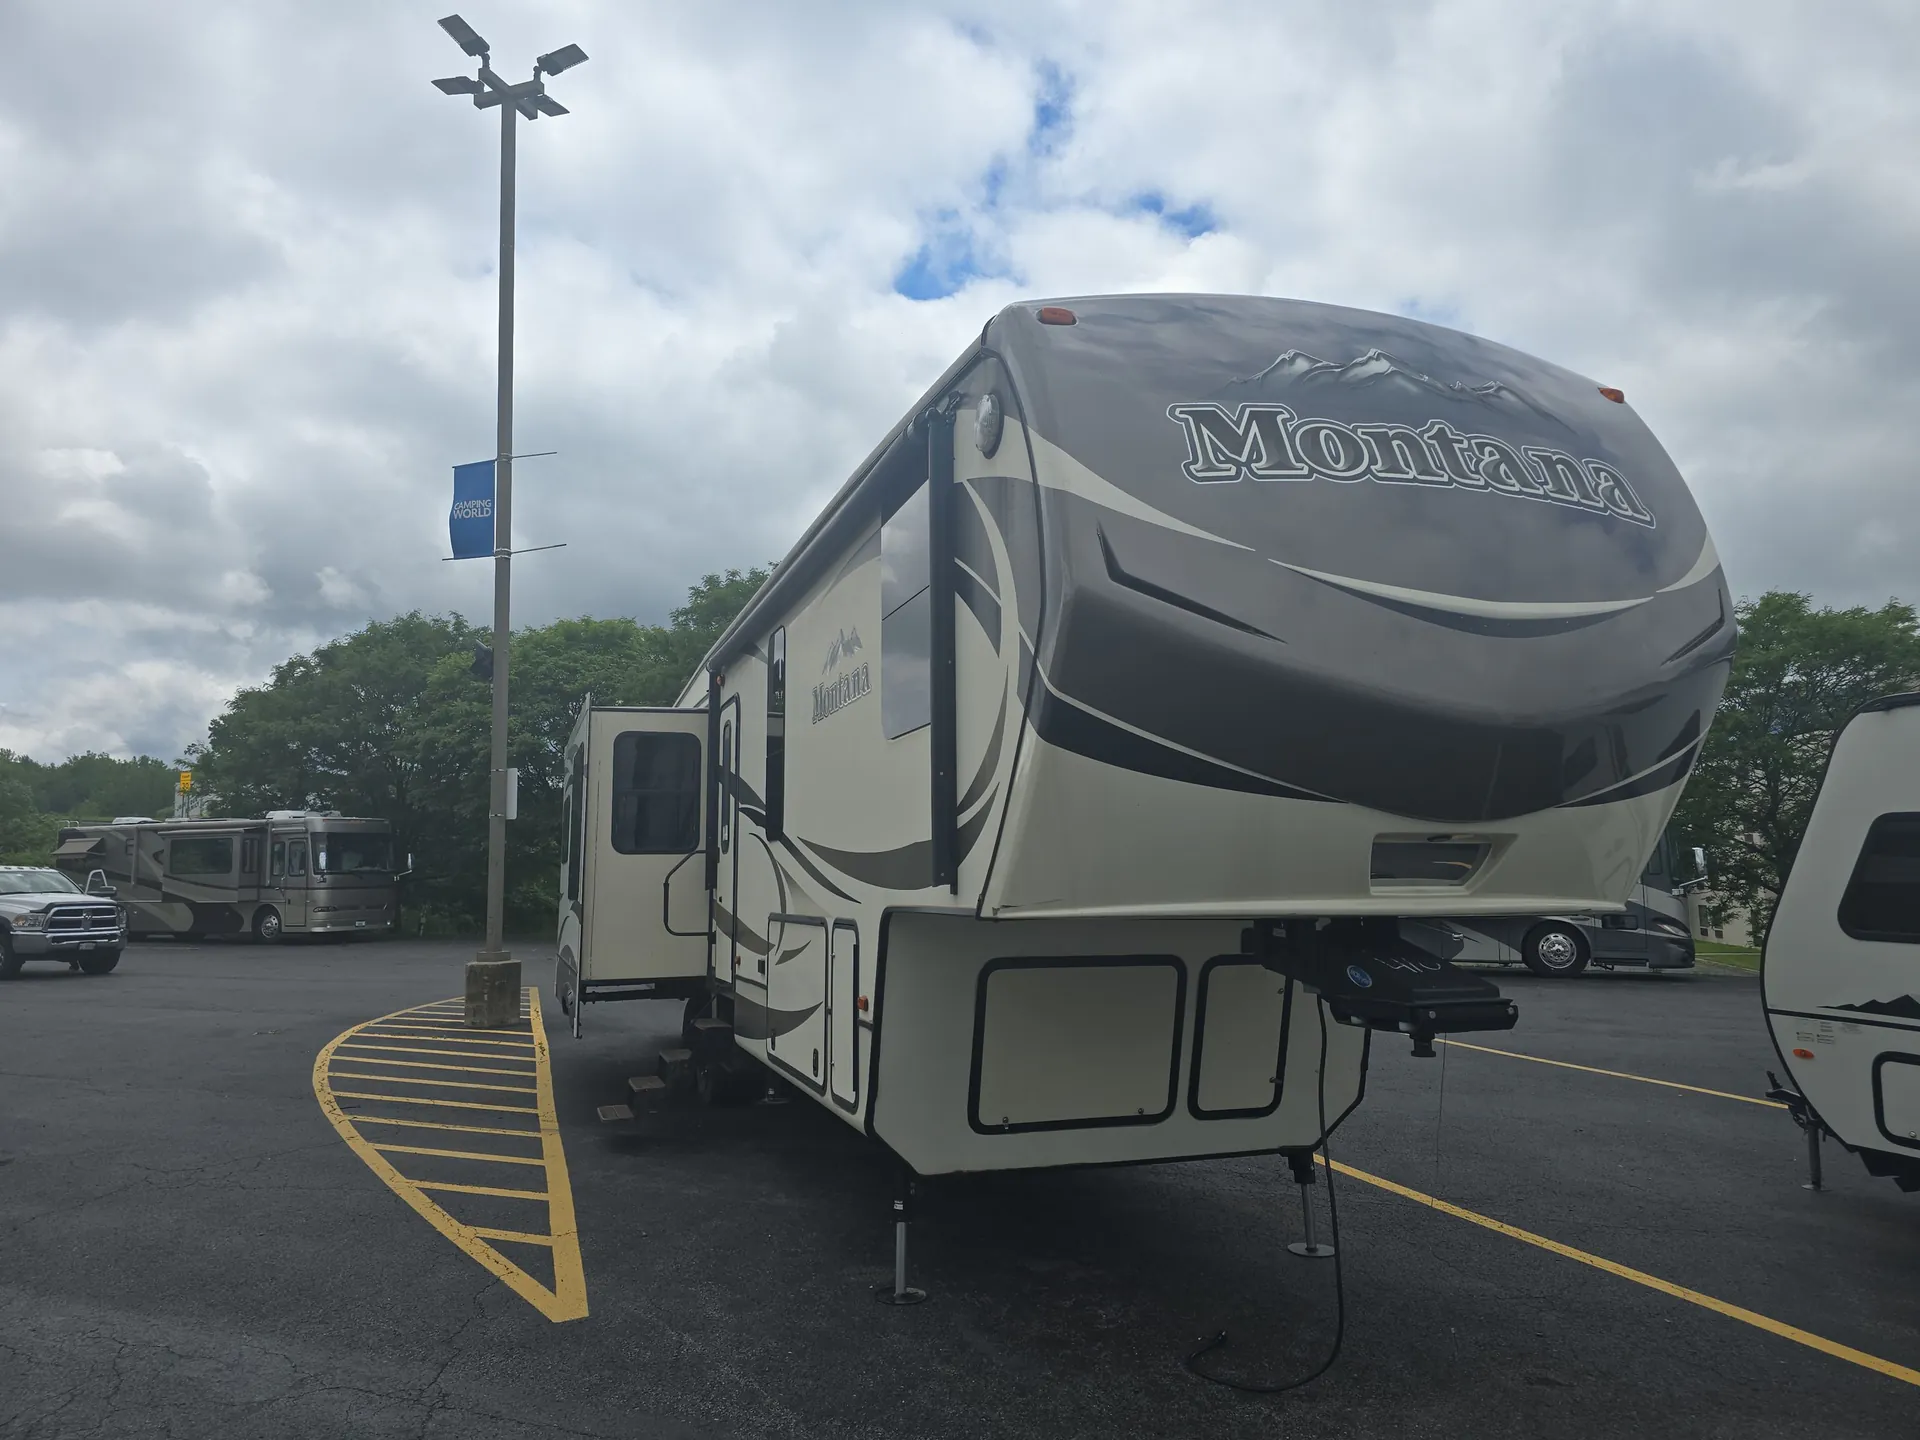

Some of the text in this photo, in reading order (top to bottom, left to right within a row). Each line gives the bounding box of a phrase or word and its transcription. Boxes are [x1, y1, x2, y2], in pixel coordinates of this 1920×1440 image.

[1167, 402, 1655, 528] Montana
[453, 508, 492, 519] WORLD
[454, 499, 492, 510] CAMPING
[812, 662, 872, 725] Montana
